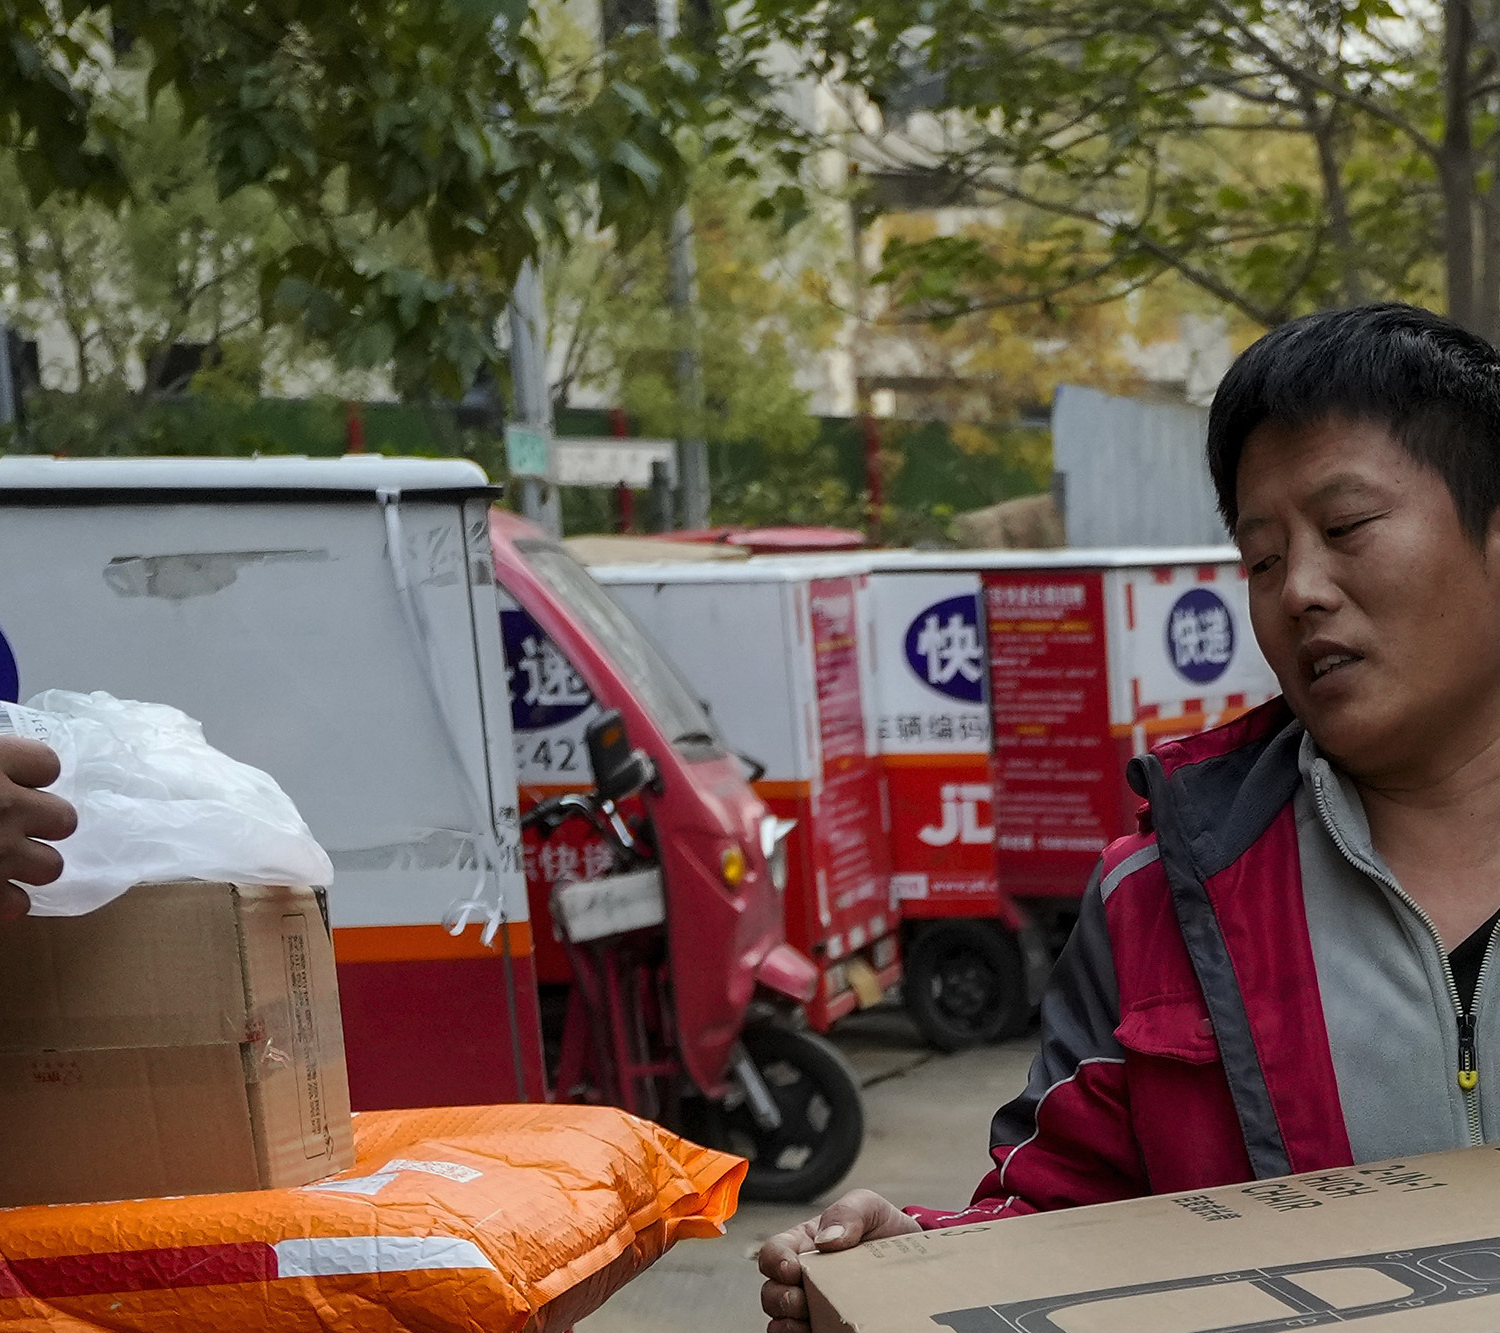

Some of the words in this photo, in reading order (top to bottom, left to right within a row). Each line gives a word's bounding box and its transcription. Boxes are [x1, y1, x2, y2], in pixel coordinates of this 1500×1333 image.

[916, 612, 984, 684] 快
[1299, 1173, 1379, 1199] HIGH
[1358, 1164, 1448, 1194] 2-IN-1
[1241, 1182, 1324, 1214] CHAIR
